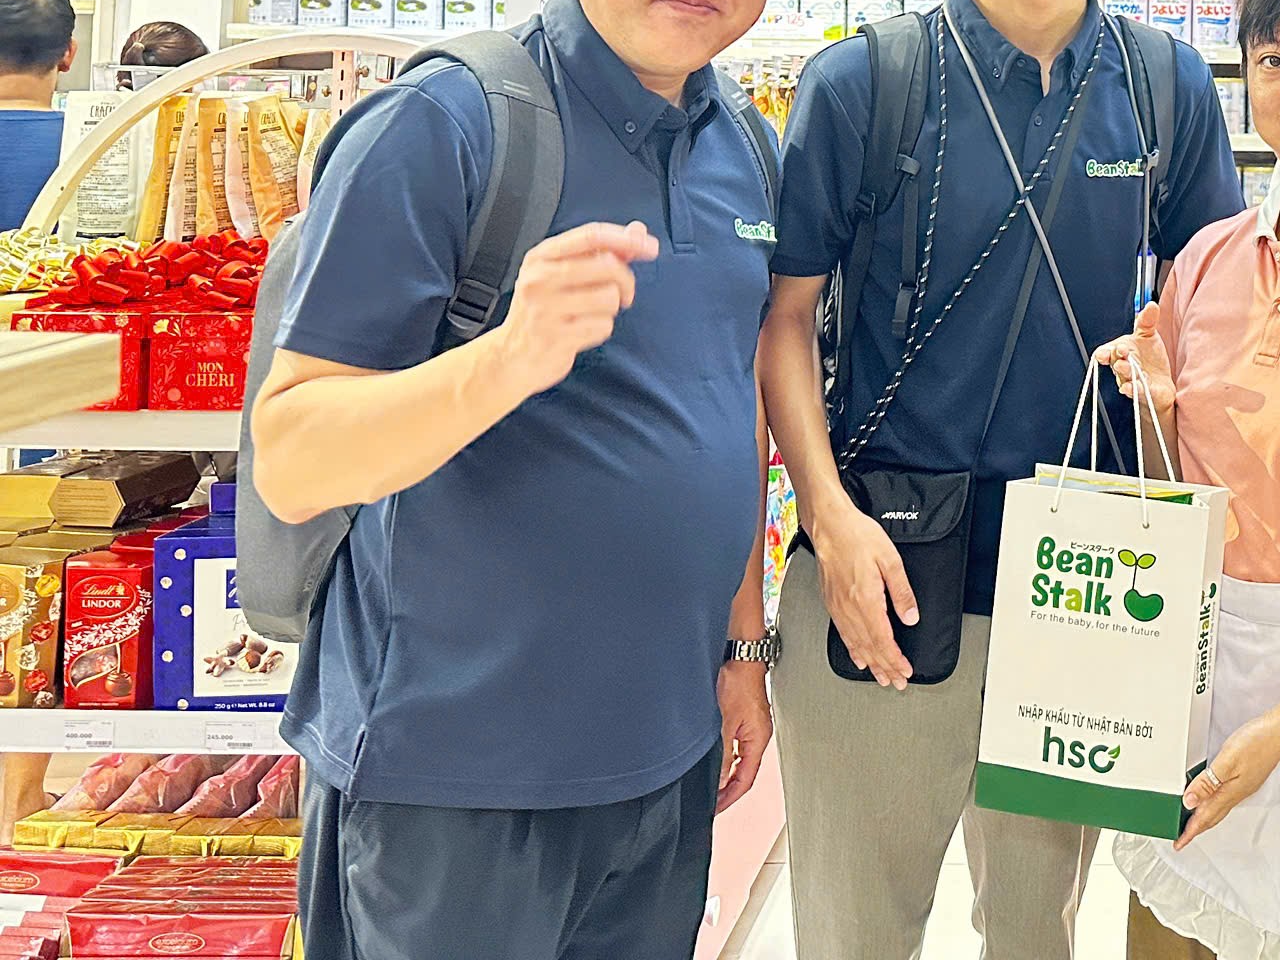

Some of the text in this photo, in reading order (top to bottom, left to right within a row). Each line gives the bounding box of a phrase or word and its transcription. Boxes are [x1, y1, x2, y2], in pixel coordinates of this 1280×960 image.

[185, 373, 235, 387] CHERI
[197, 361, 225, 373] MON
[1036, 536, 1114, 579] Bean
[81, 599, 121, 608] LINDOR
[1031, 573, 1112, 617] Stalk
[1030, 610, 1047, 620] For
[1049, 613, 1065, 623] the
[1095, 620, 1110, 630] for
[1112, 623, 1128, 633] the
[1131, 625, 1160, 638] future
[1196, 603, 1211, 695] BeanStalk
[1018, 703, 1044, 723] NHẬP
[1072, 711, 1086, 728] TỪ
[1086, 716, 1112, 736] NHẬT
[1113, 718, 1134, 737] BẢN
[1135, 720, 1153, 739] BỞI
[1042, 726, 1120, 774] hsc
